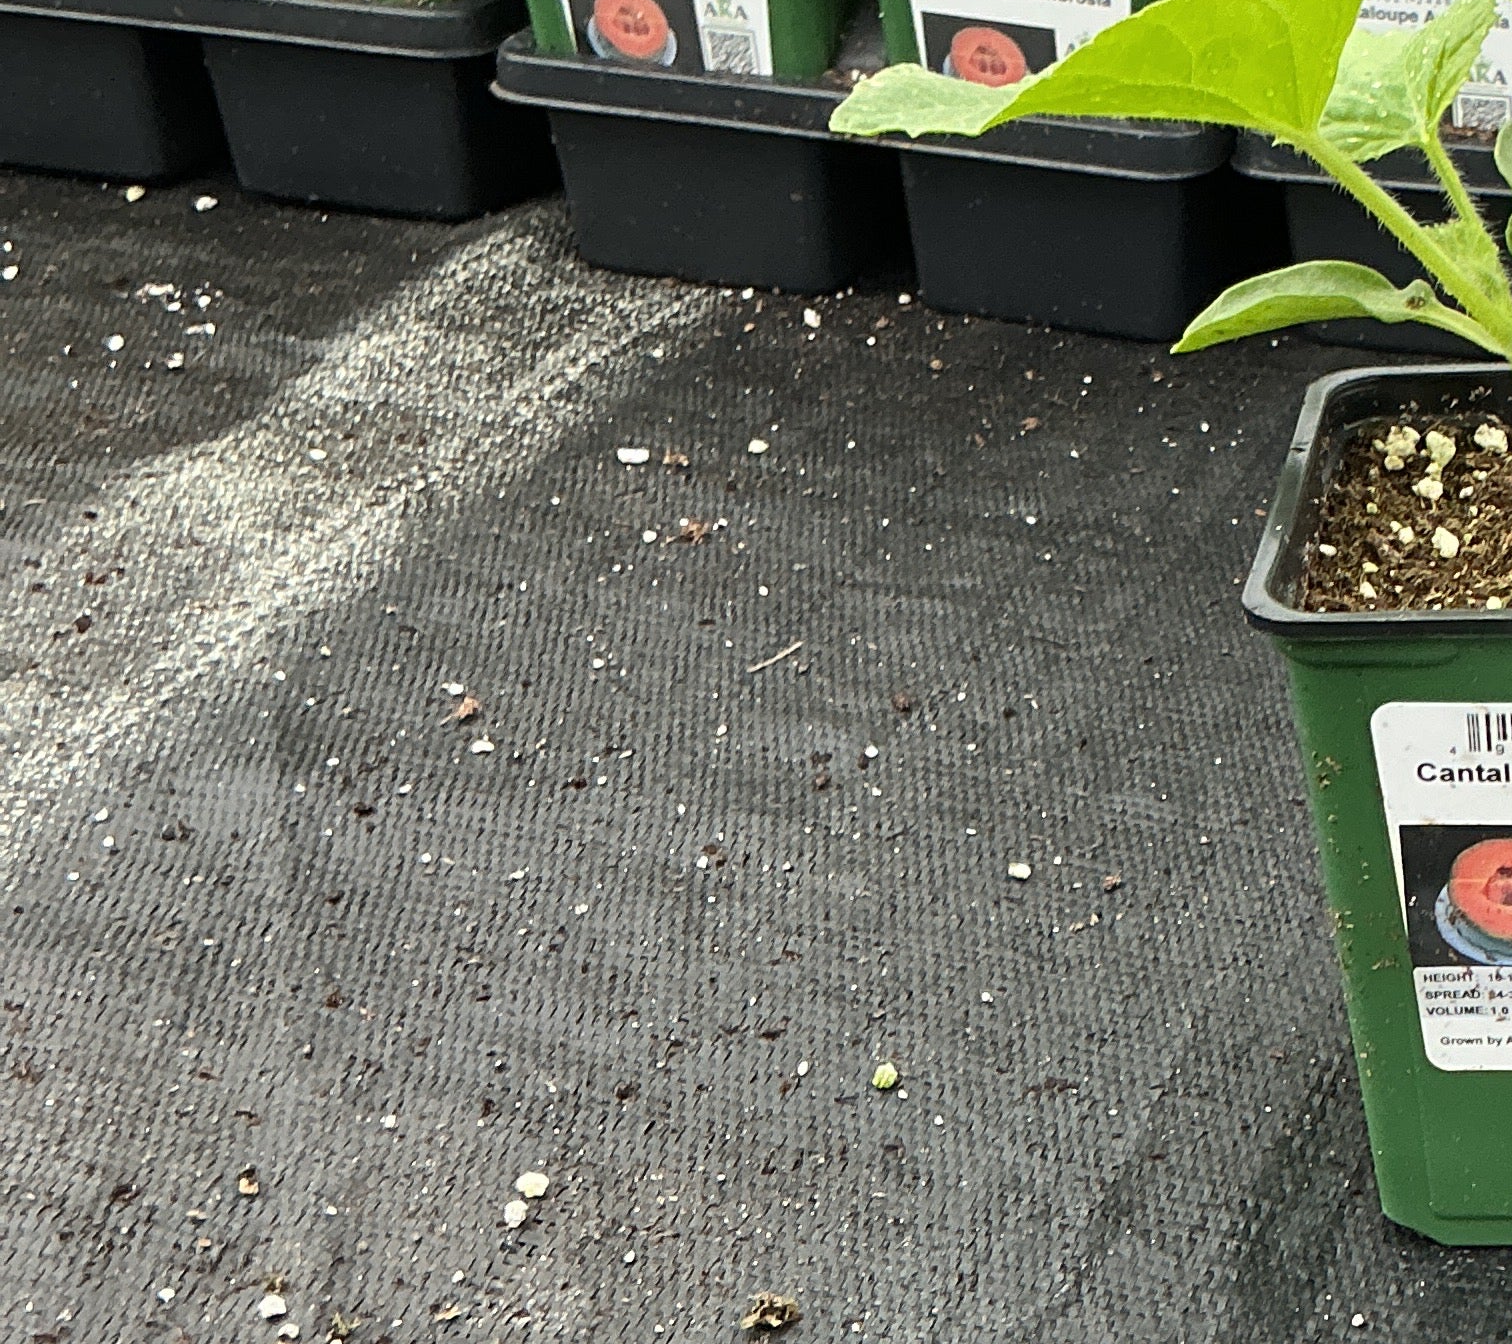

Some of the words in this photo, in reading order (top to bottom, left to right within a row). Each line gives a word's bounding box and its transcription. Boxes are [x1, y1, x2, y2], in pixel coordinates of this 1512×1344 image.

[1359, 6, 1419, 26] aloupe
[1449, 746, 1457, 756] 4
[1426, 1007, 1487, 1016] VOLUME:
[1440, 1036, 1483, 1046] Grown
[1487, 1036, 1503, 1047] by
